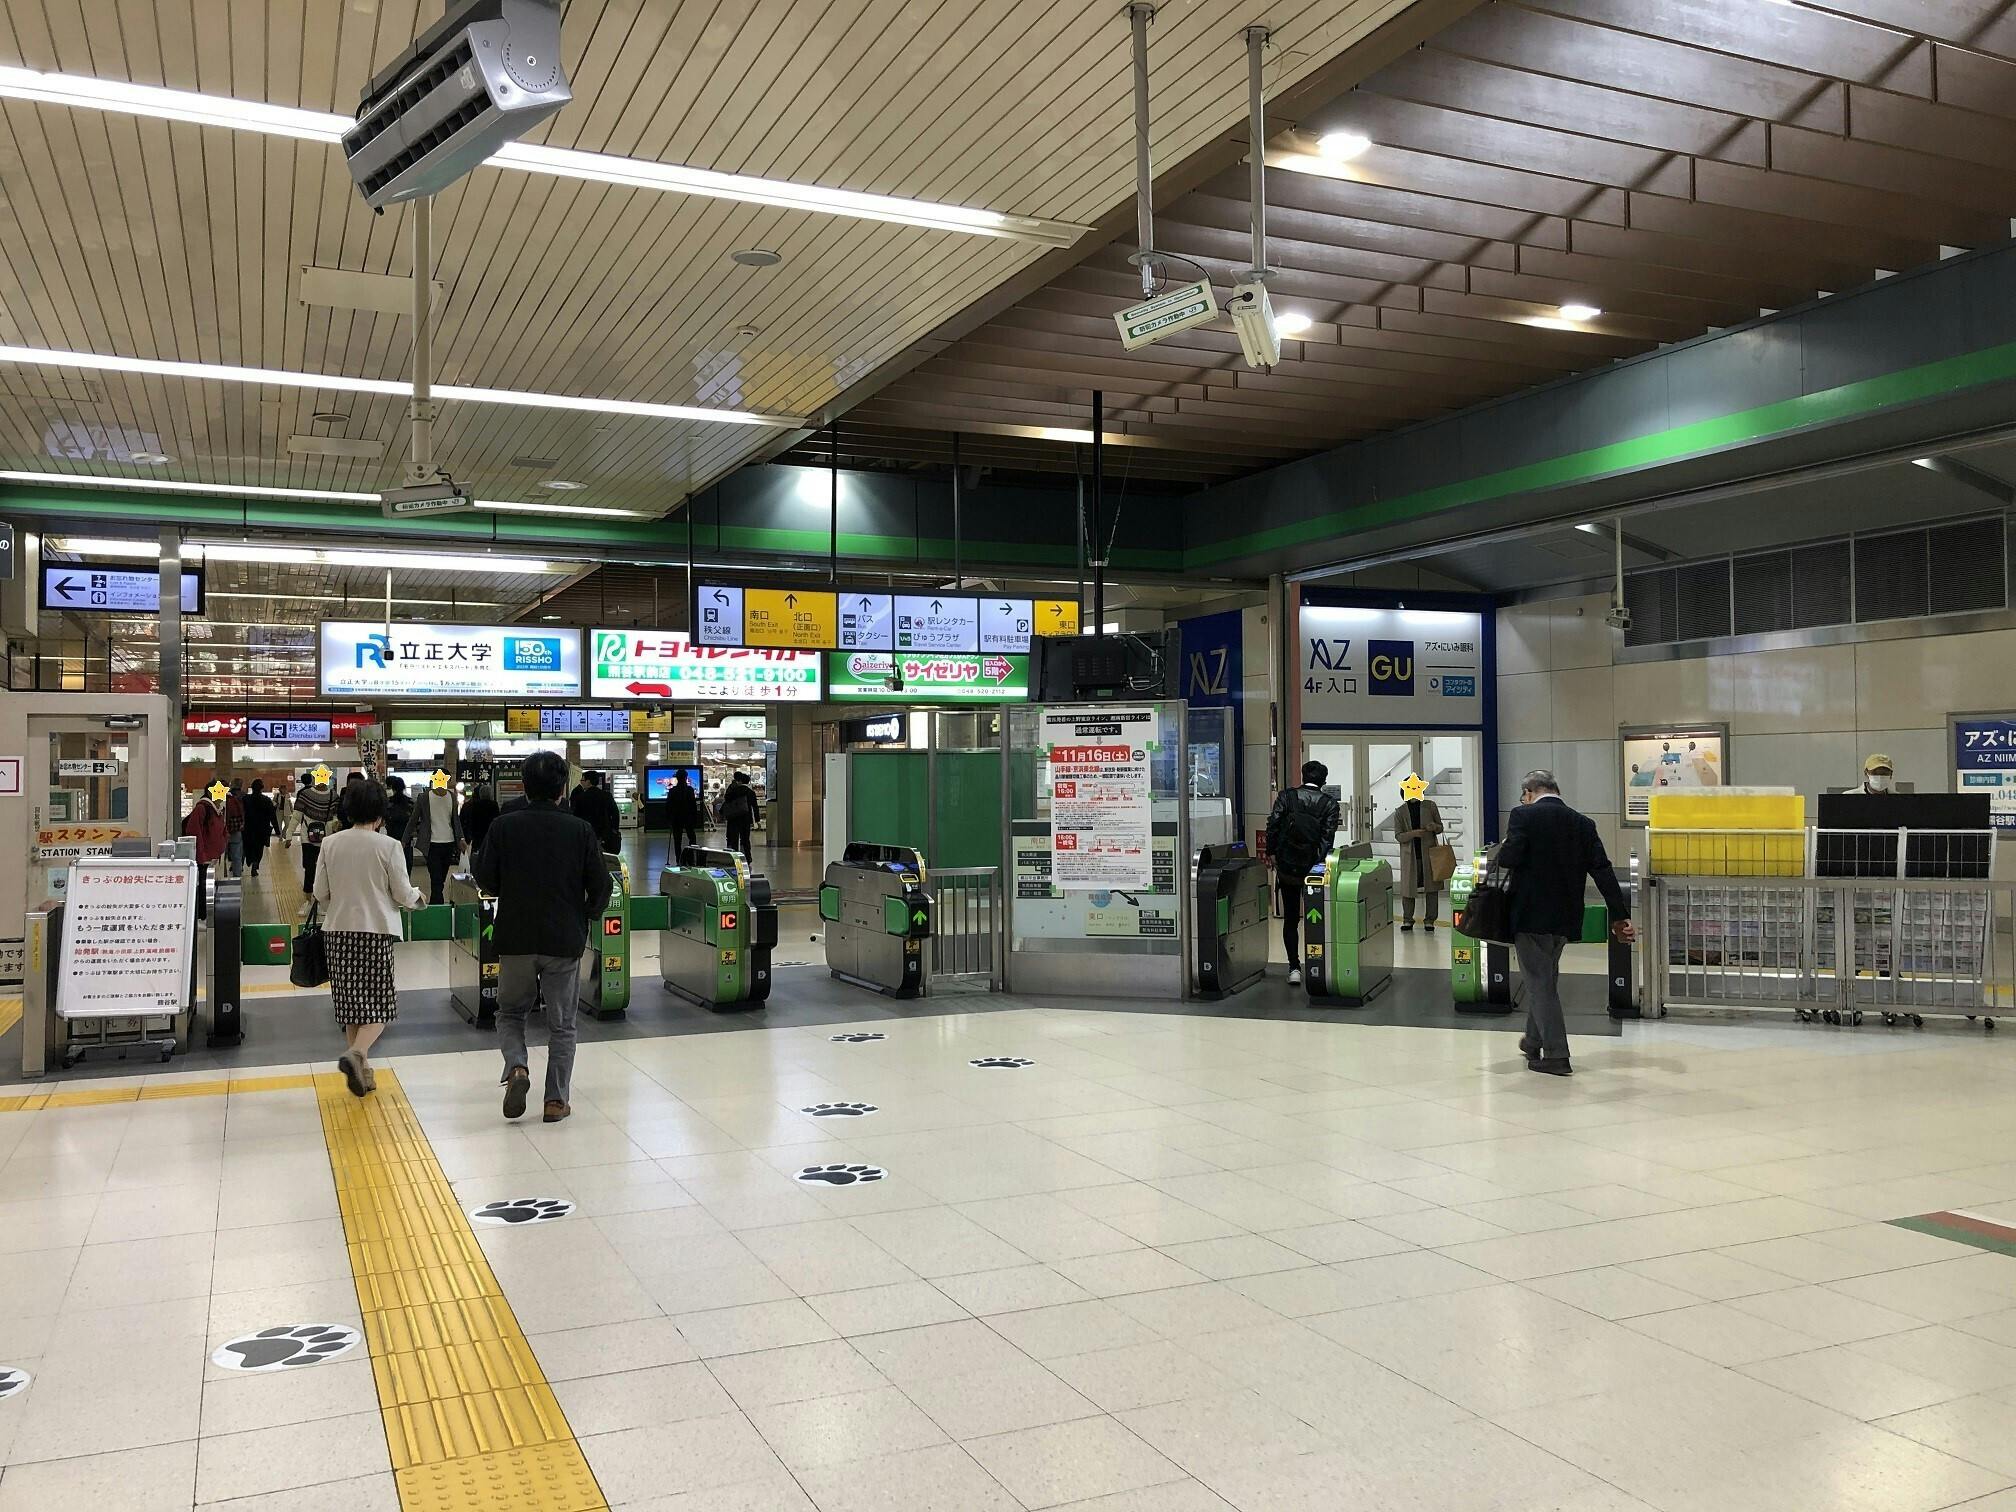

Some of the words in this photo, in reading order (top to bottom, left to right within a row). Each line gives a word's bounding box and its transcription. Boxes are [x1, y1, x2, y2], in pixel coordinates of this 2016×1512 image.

[749, 610, 769, 620] 南口
[793, 612, 813, 622] 北口
[857, 615, 874, 623] バス
[927, 616, 974, 626] 駅レンタカー
[1059, 620, 1075, 629] 東口
[703, 625, 732, 635] 秩父線
[857, 631, 888, 640] タクシー
[913, 633, 960, 642] びゅうプラザ
[984, 634, 1029, 644] 駅有料駐車場
[400, 642, 492, 661] 立正大学
[1424, 641, 1474, 653] アズ・にいみ眼科
[515, 656, 553, 664] RISSHO
[904, 662, 978, 680] サイゼリヤ
[1371, 655, 1412, 681] GU
[1304, 677, 1323, 694] 4F
[1327, 677, 1357, 694] 入口
[697, 685, 798, 697] ここより徒歩1分
[288, 723, 318, 732] 秩父線
[744, 721, 763, 729] びゅう
[1976, 753, 1992, 763] AZ
[41, 848, 80, 857] STATION
[82, 874, 185, 885] きっぷの紛失にご注意
[718, 881, 737, 893] IC
[721, 895, 736, 904] 専用
[721, 913, 736, 929] IC
[77, 923, 187, 932] もう一度運賃をいただきます。
[605, 919, 621, 935] IC
